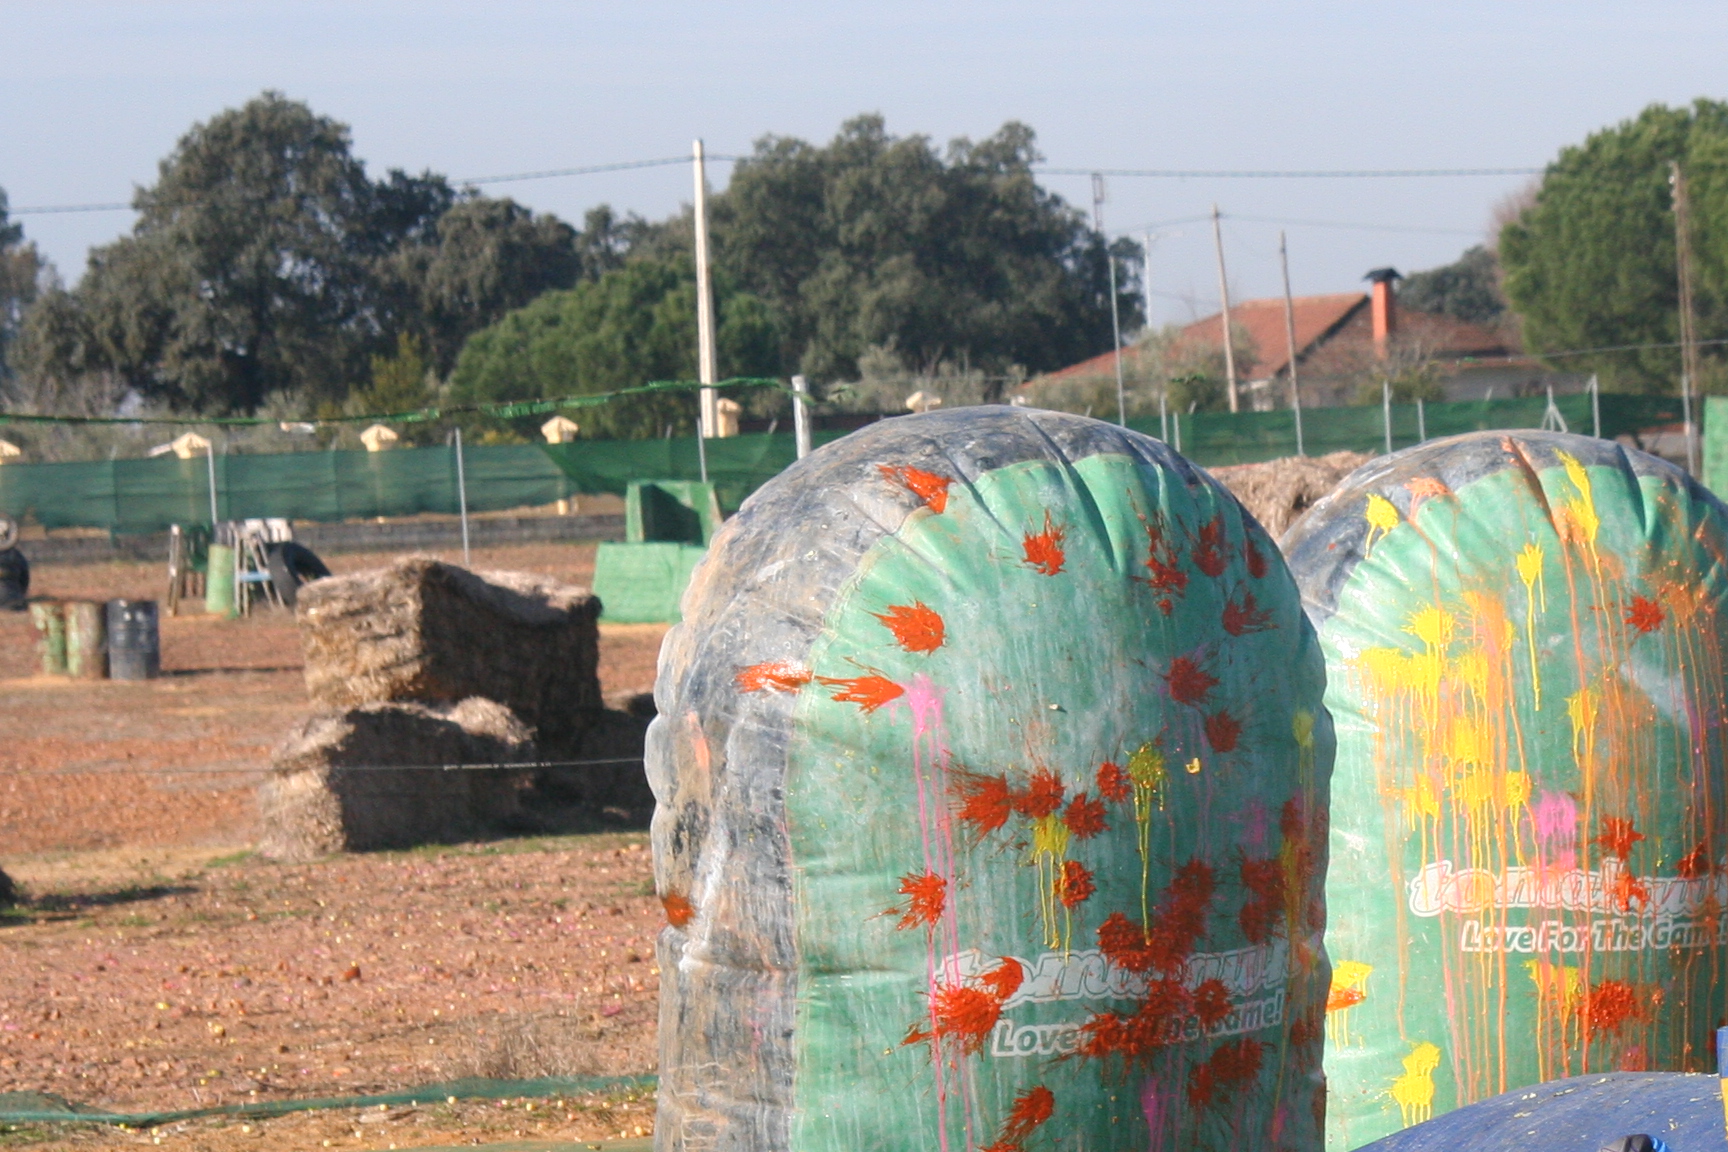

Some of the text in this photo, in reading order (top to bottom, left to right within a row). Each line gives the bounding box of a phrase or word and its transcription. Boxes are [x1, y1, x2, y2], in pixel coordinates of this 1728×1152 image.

[1462, 920, 1535, 953] Love
[1538, 920, 1590, 953] For
[1592, 918, 1646, 952] The
[993, 1021, 1077, 1056] Love
